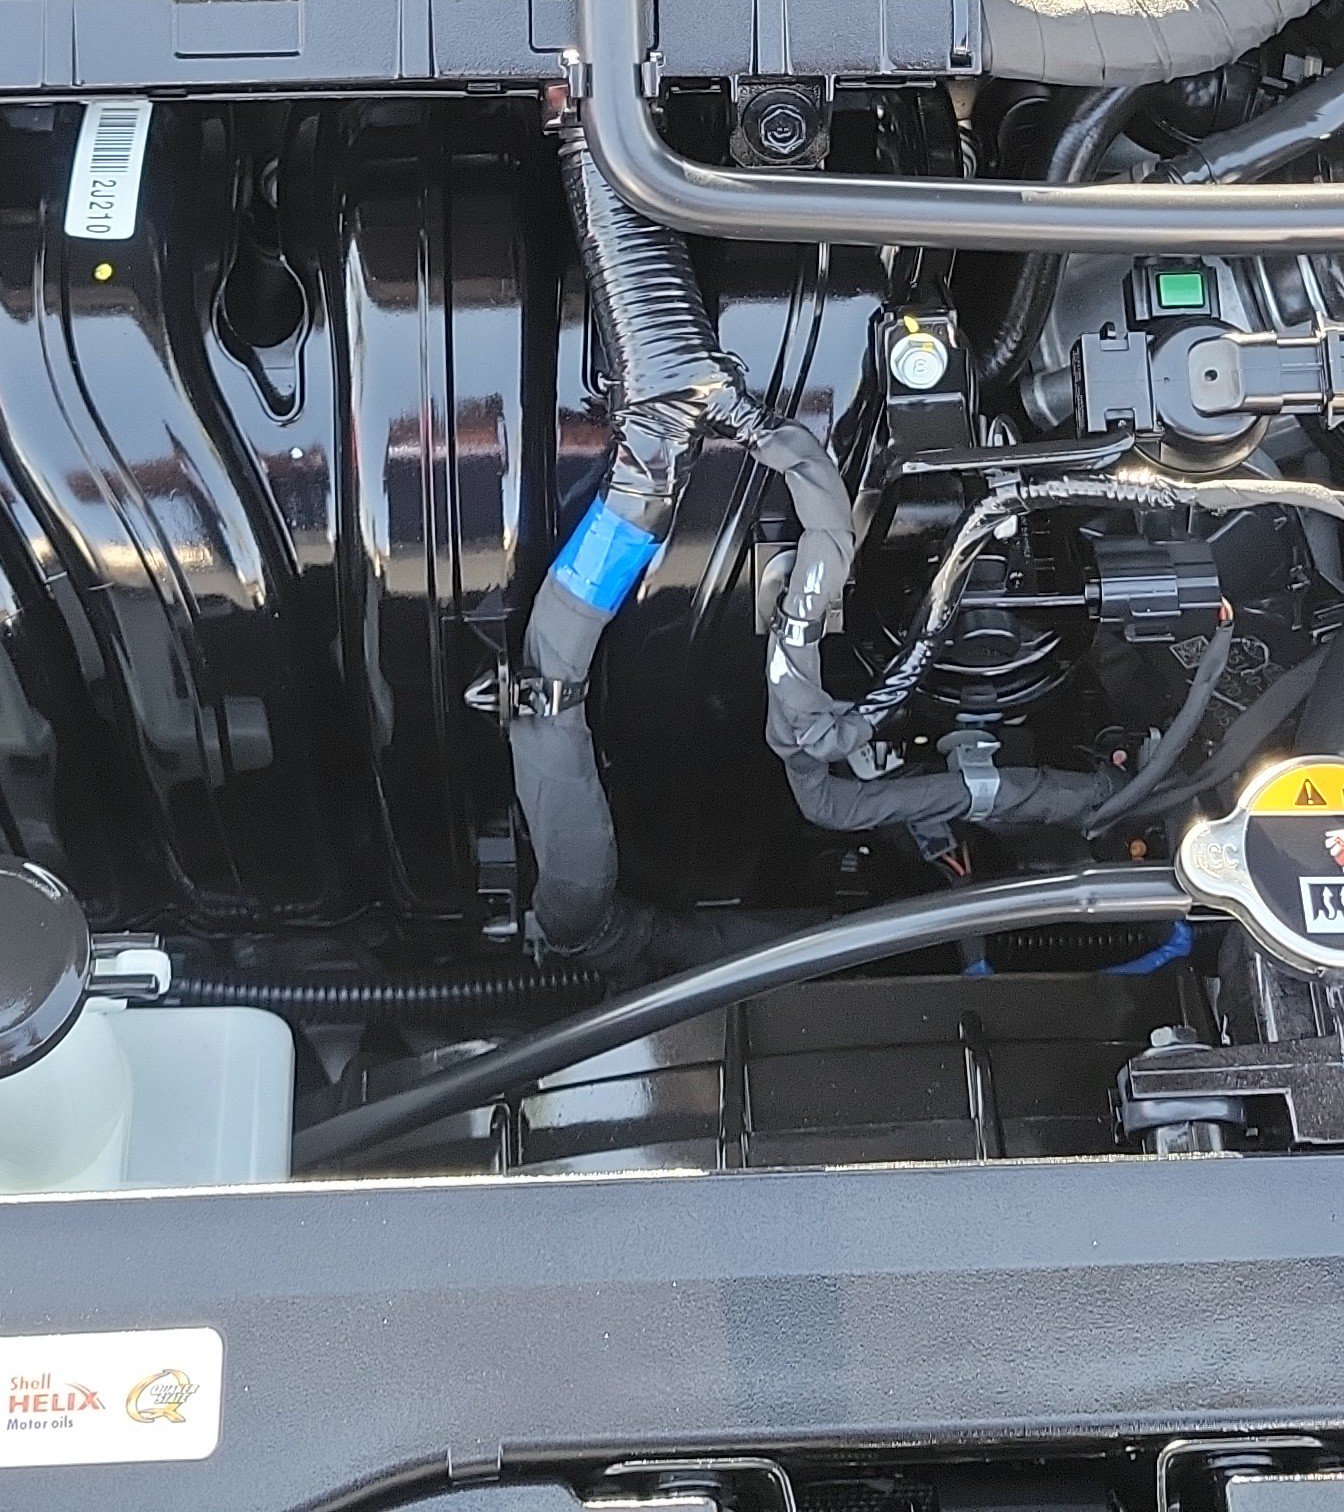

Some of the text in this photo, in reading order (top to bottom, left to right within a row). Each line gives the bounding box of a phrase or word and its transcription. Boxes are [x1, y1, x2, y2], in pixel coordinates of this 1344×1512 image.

[85, 179, 117, 234] 2J210
[10, 1372, 52, 1391] Shell
[8, 1385, 104, 1413] HELIX
[6, 1414, 74, 1431] Motor oils
